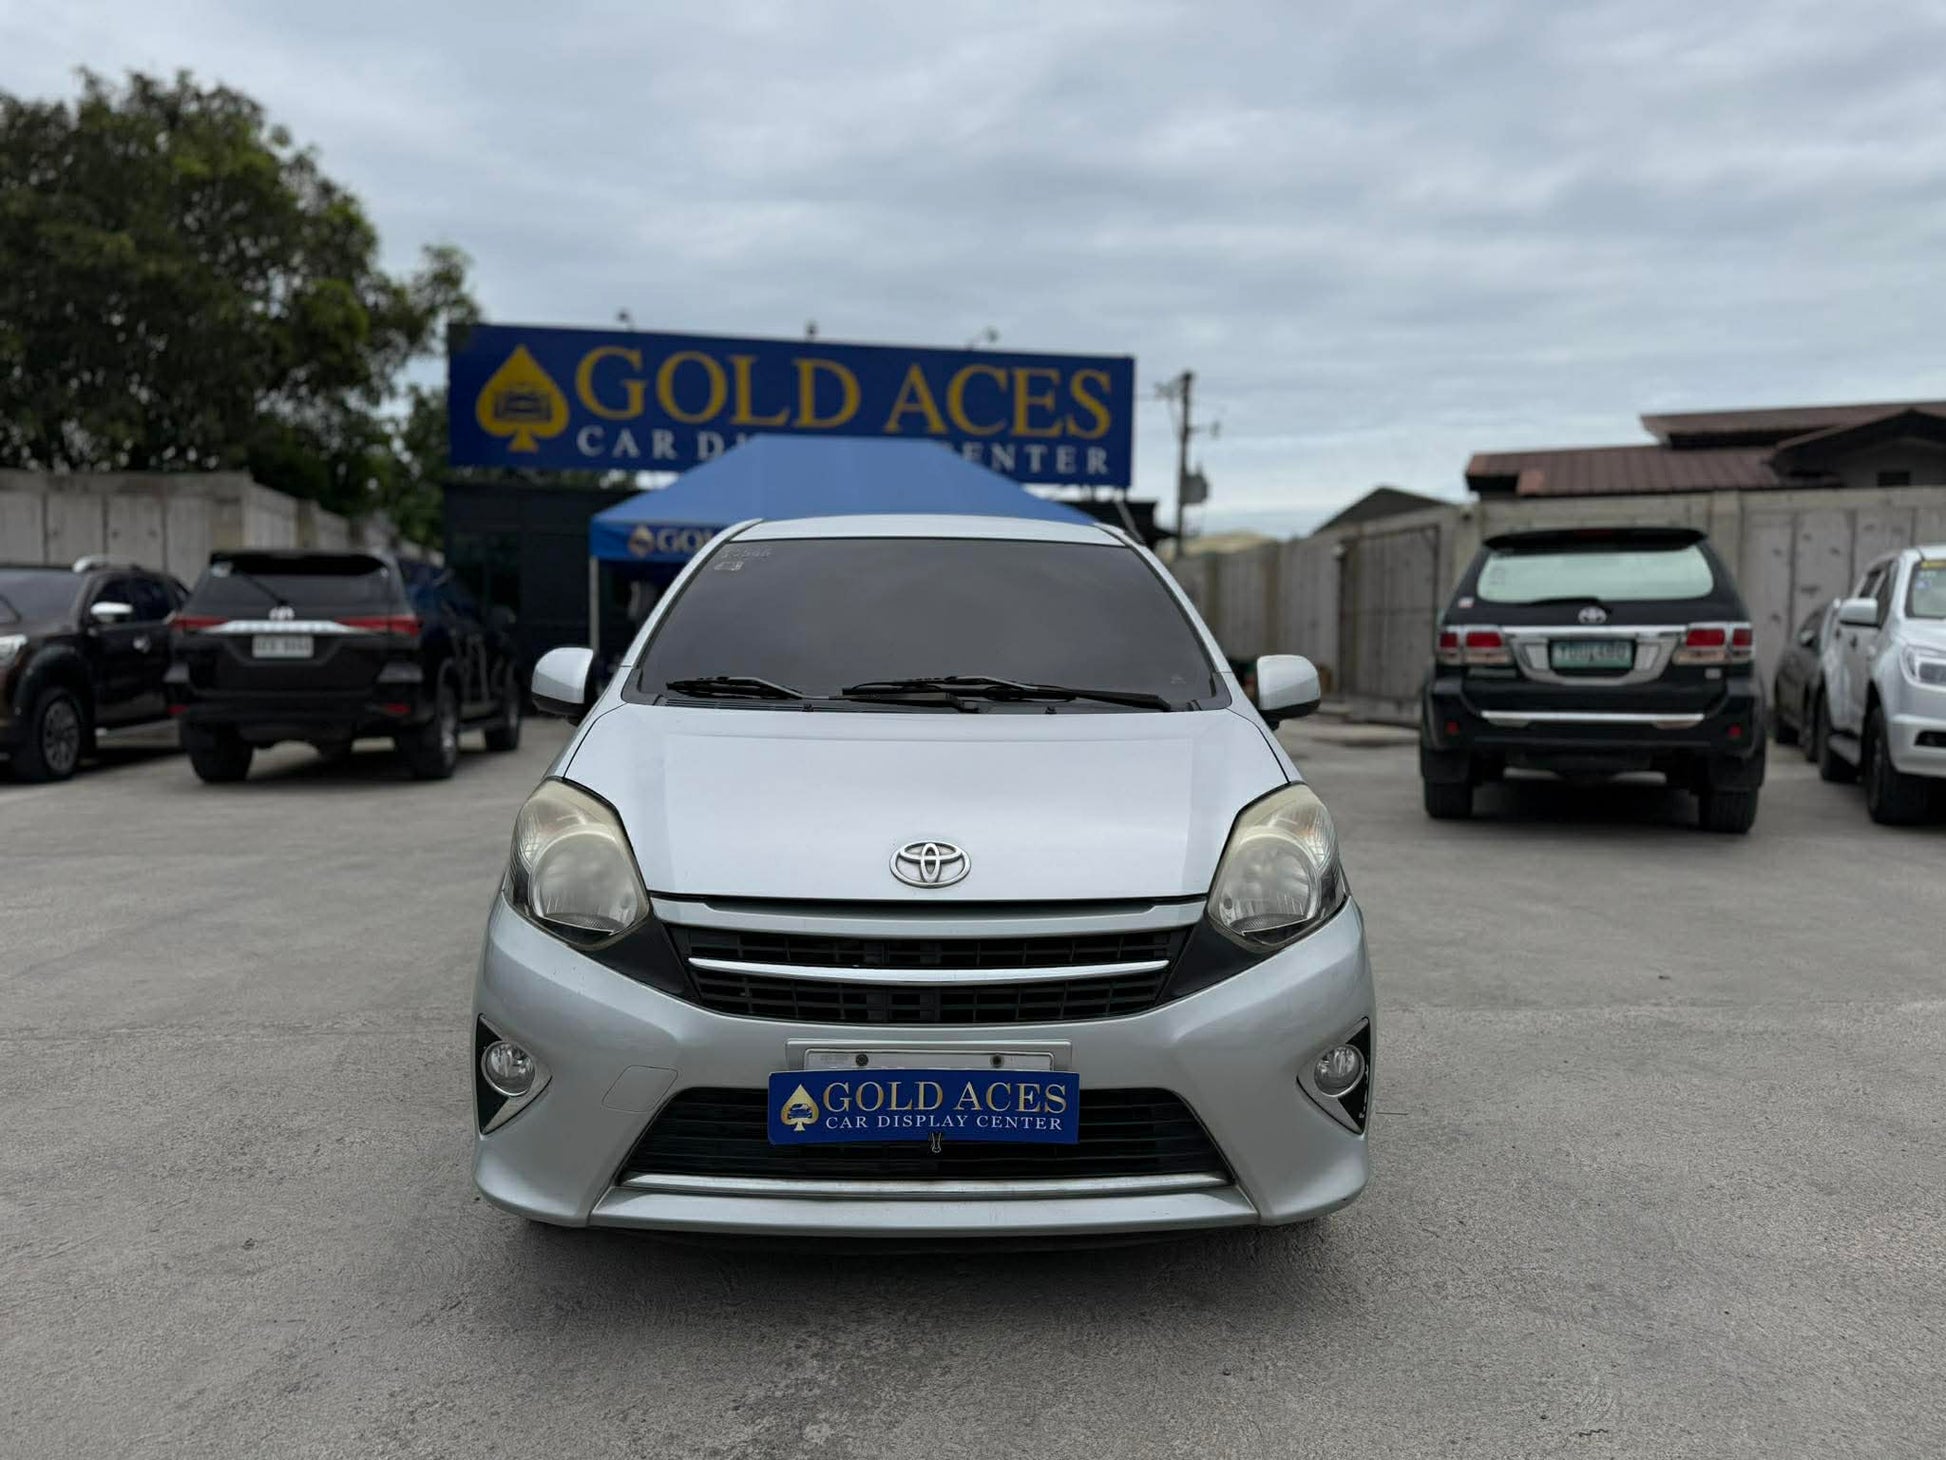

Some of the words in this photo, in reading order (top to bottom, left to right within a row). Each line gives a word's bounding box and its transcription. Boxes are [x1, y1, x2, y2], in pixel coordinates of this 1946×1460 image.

[575, 345, 861, 428] GOLD
[883, 362, 1111, 440] ACES
[576, 424, 679, 460] CAR
[945, 440, 1109, 475] ENTER
[823, 1081, 943, 1112] GOLD
[953, 1081, 1068, 1114] ACES
[825, 1116, 869, 1129] CAR
[878, 1114, 968, 1128] DISPLAY
[976, 1115, 1063, 1130] CENTER
